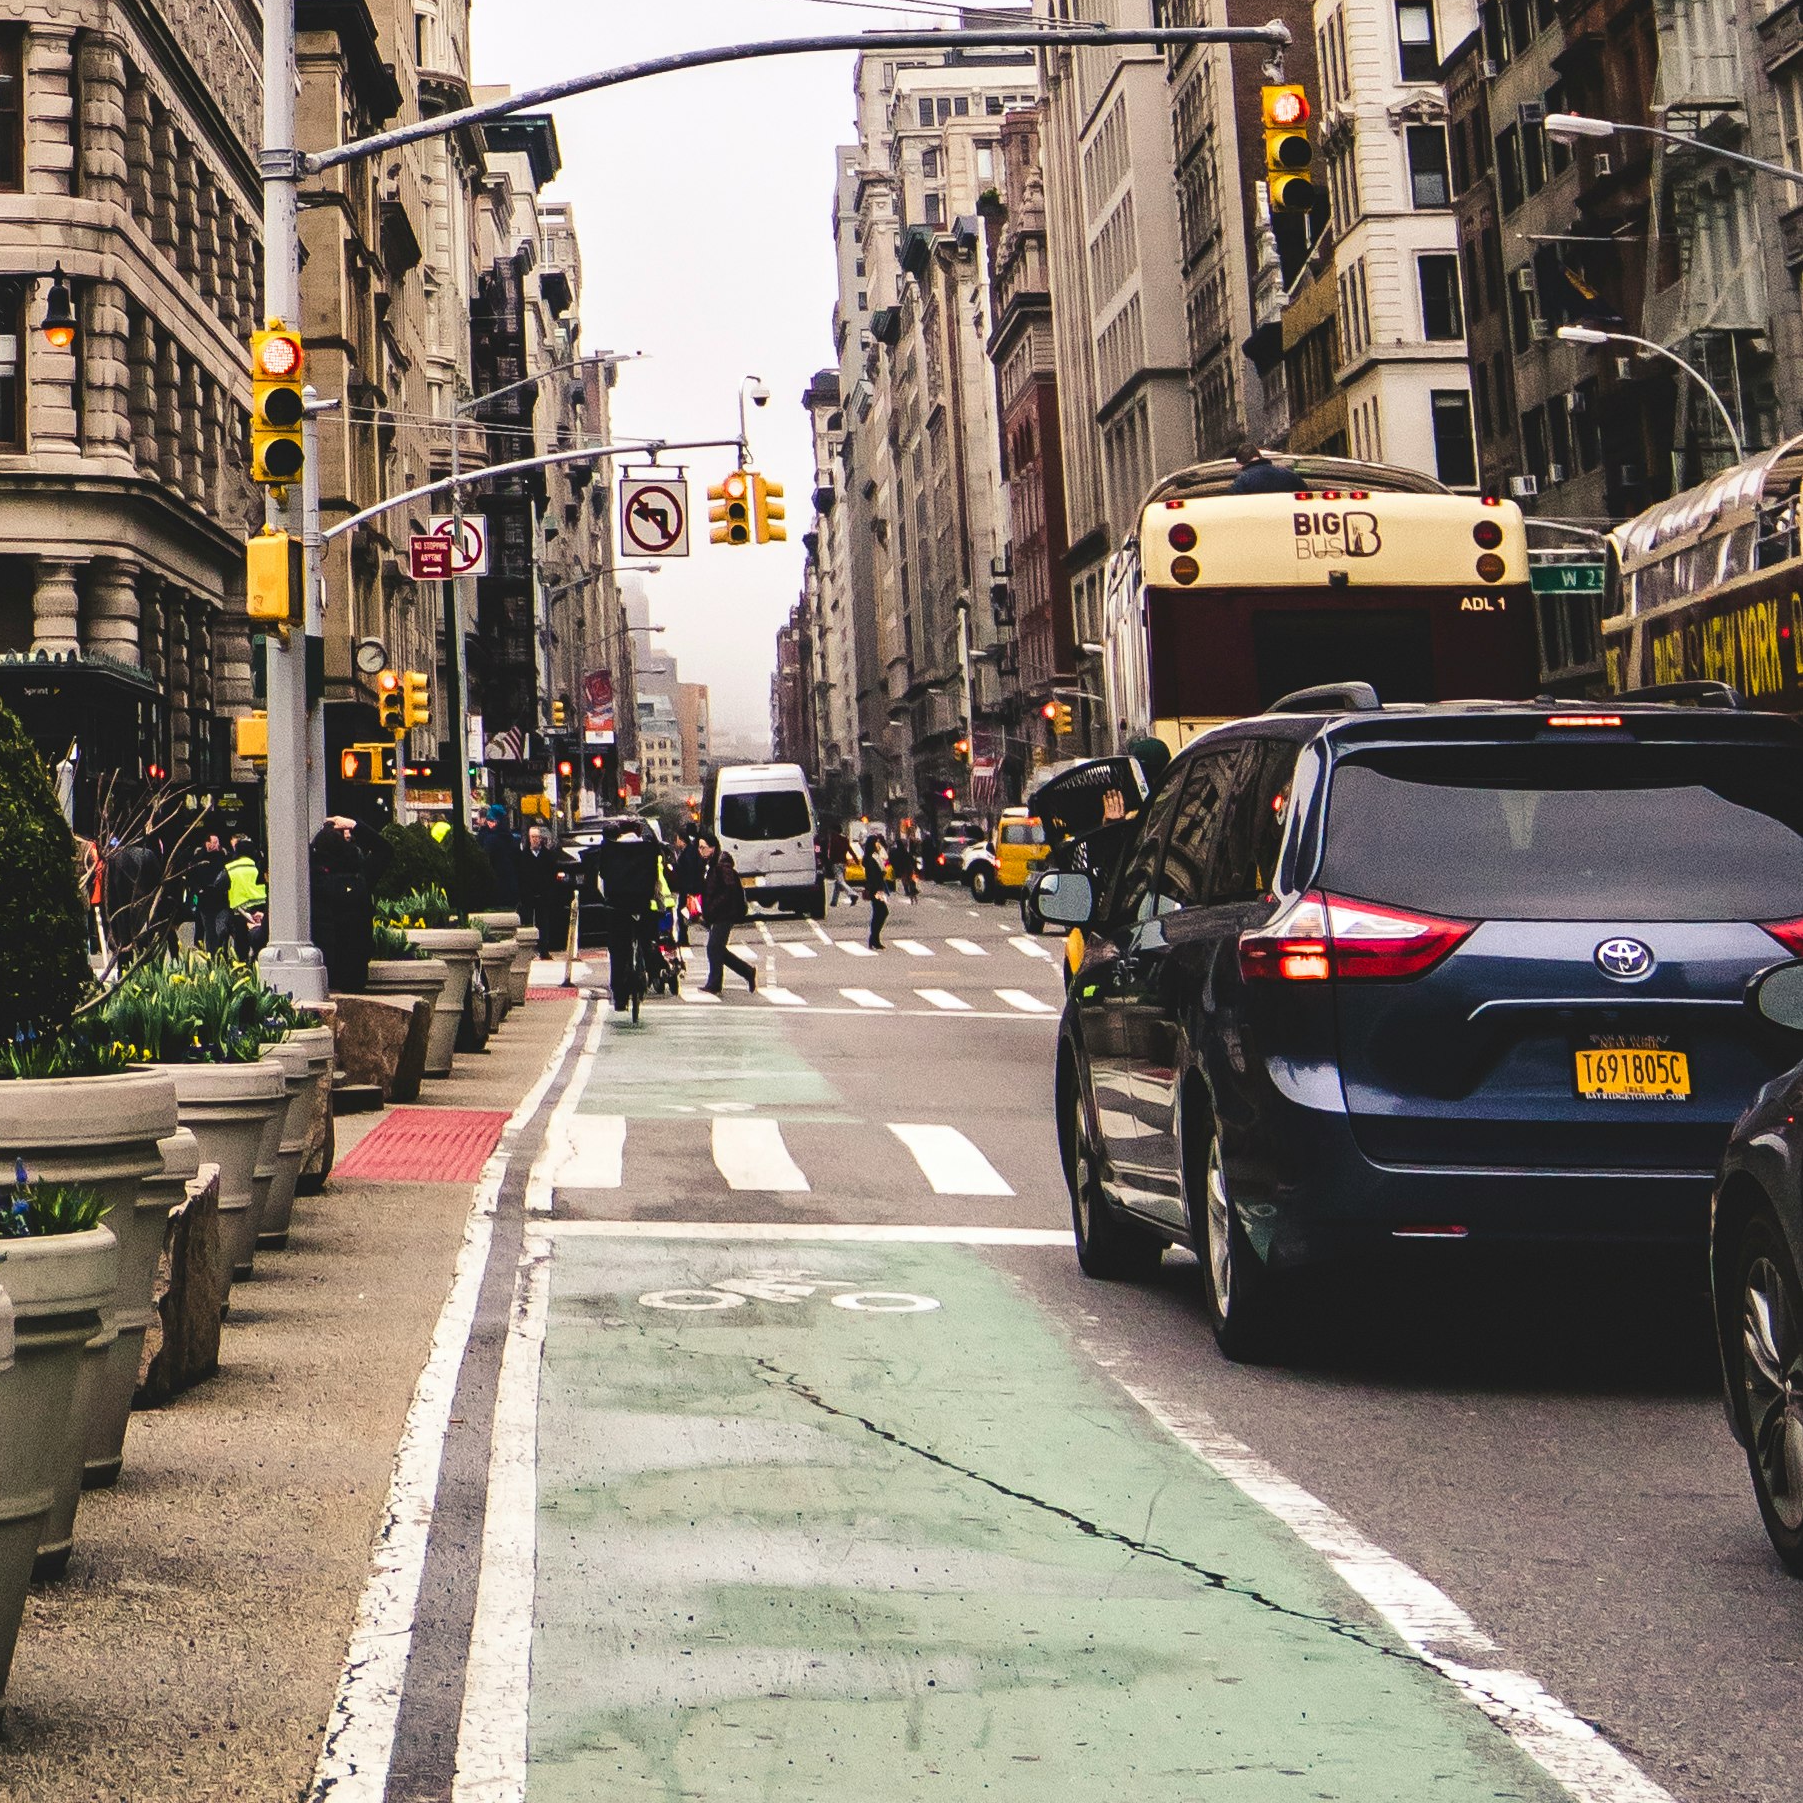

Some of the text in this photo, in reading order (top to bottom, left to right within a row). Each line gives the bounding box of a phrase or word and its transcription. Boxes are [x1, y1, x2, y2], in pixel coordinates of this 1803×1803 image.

[1293, 512, 1340, 536] BIG
[1295, 537, 1345, 560] BUS
[1561, 569, 1577, 587] W
[1460, 597, 1506, 611] ADL 1
[1736, 597, 1783, 700] YORK
[23, 687, 49, 696] Sprint
[1582, 1053, 1682, 1084] T691805C
